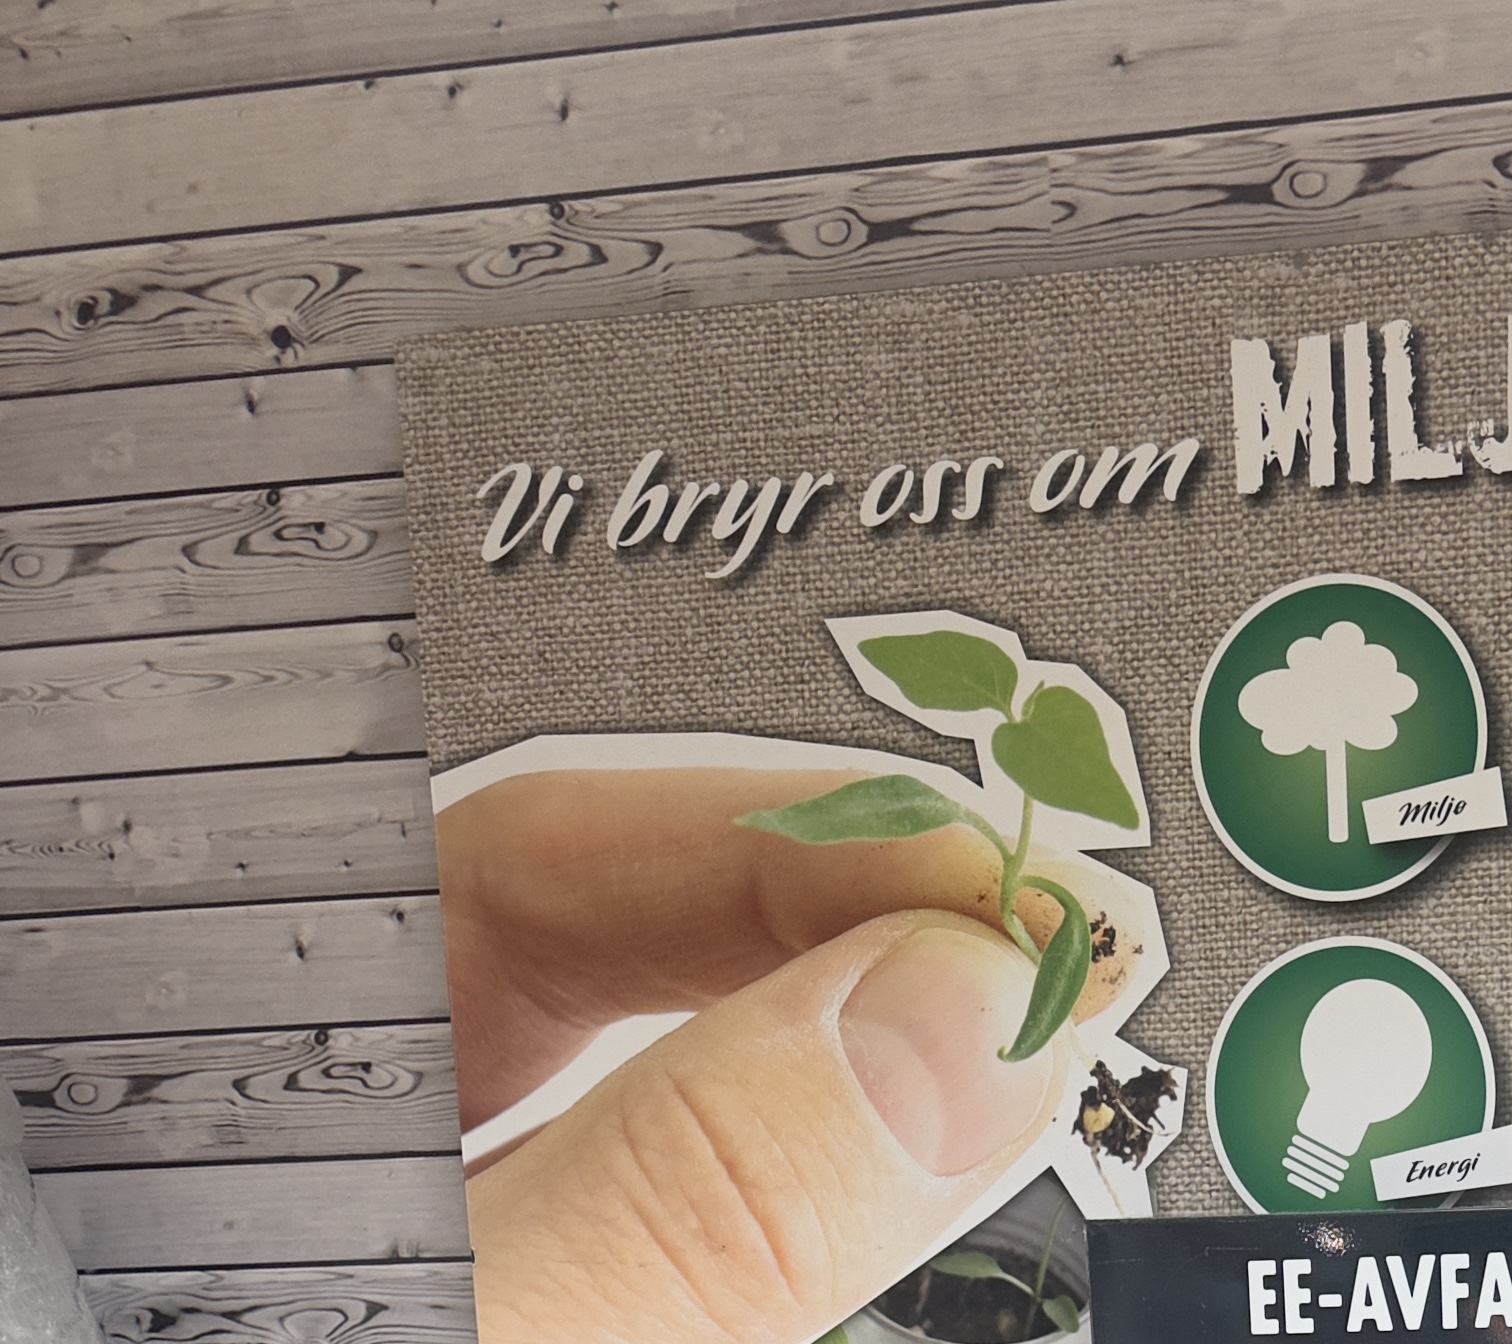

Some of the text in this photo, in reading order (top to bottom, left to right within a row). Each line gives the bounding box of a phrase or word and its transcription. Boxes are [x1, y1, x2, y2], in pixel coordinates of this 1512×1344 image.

[475, 462, 584, 563] Vi
[607, 450, 835, 580] bryr
[860, 456, 1003, 528] oss
[1030, 438, 1200, 514] om
[1405, 1151, 1481, 1185] Energi
